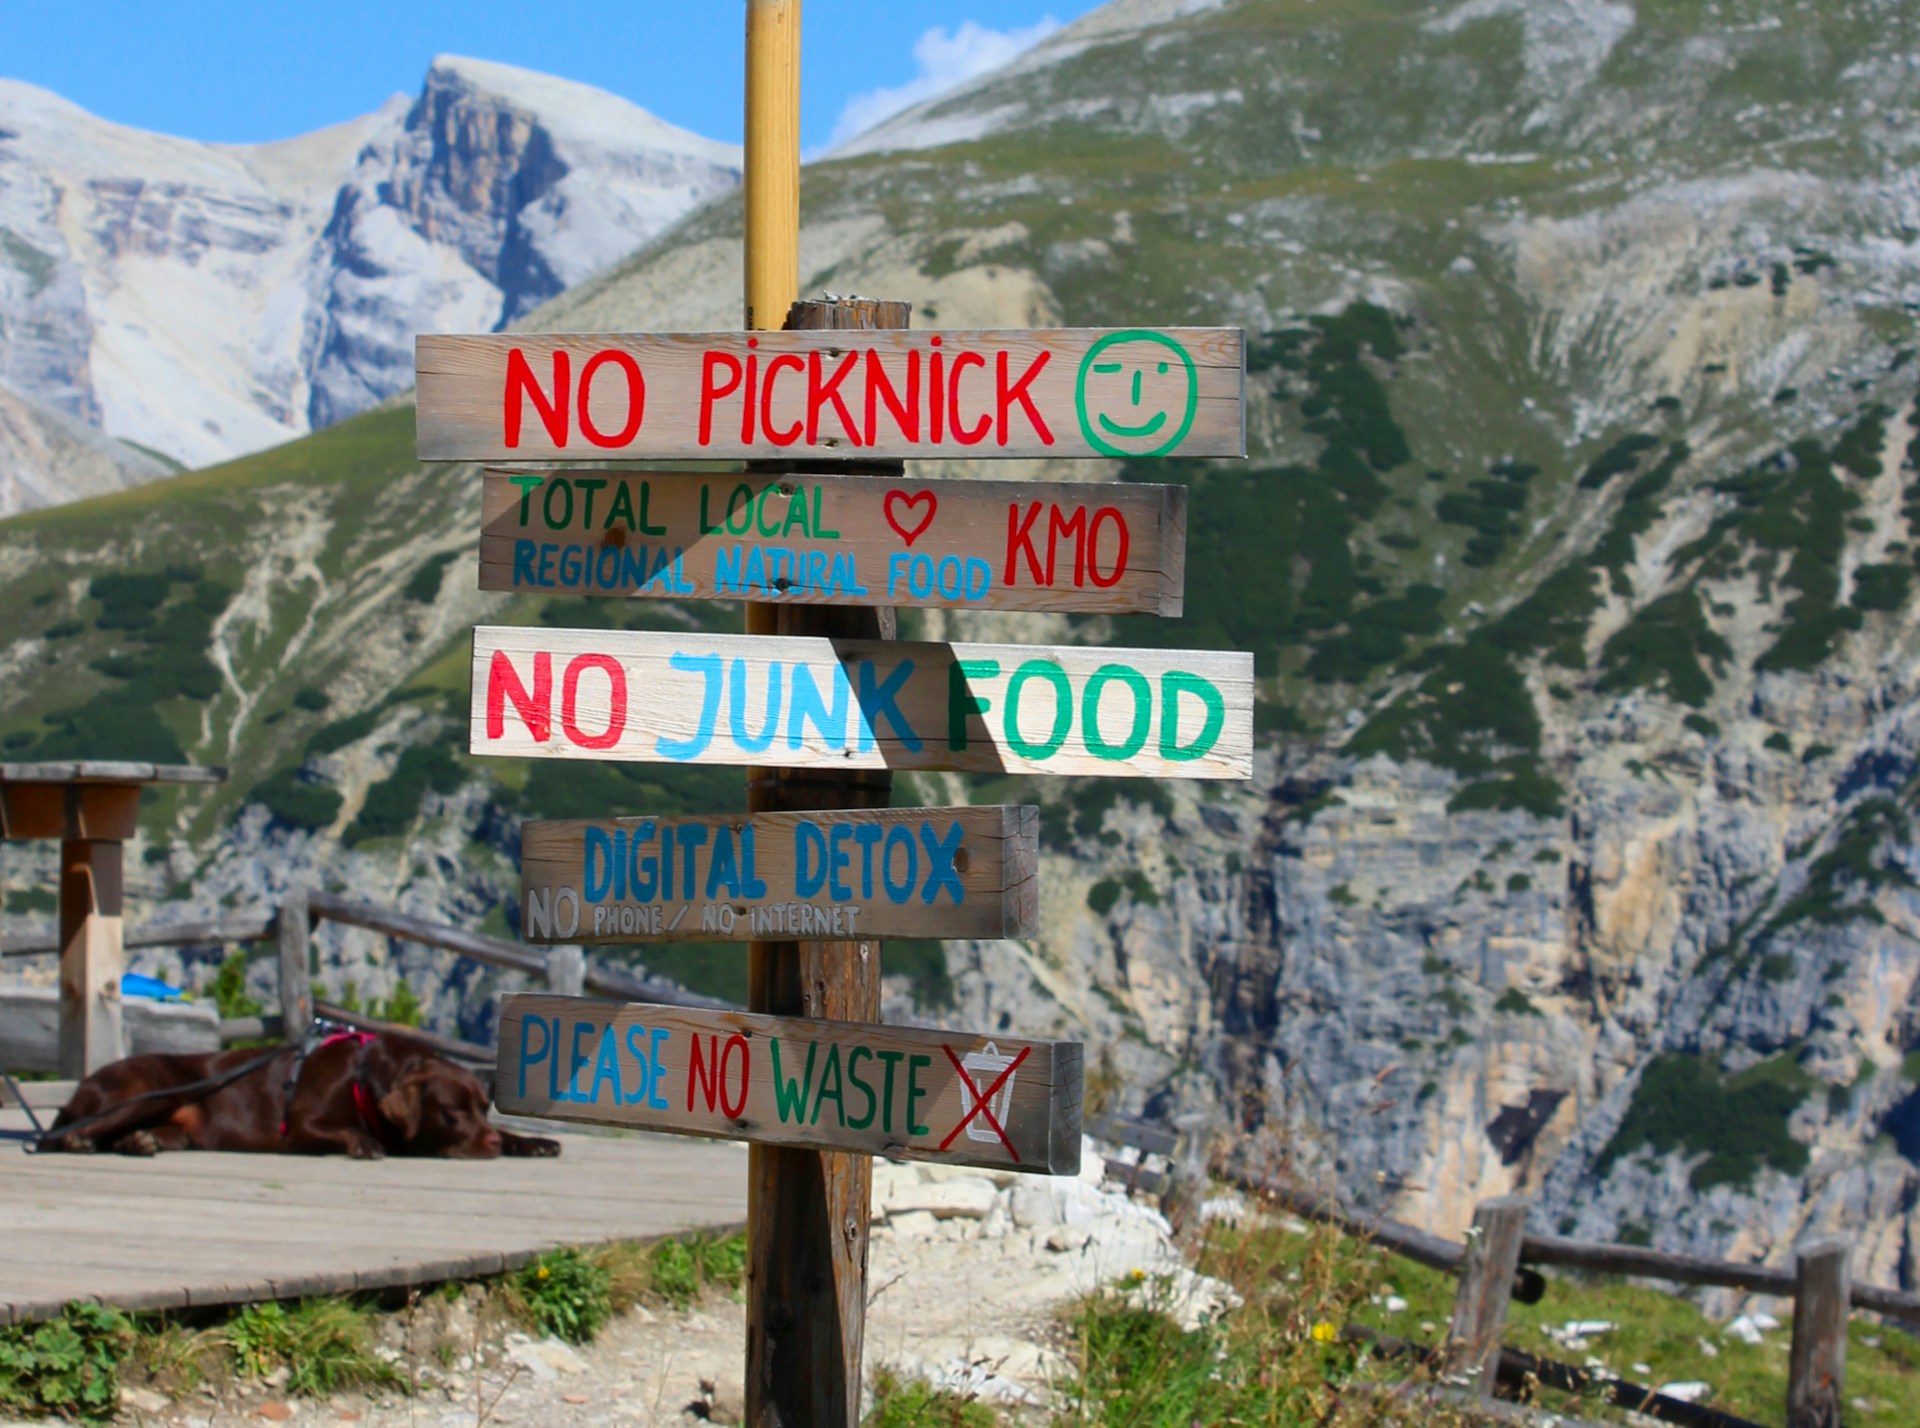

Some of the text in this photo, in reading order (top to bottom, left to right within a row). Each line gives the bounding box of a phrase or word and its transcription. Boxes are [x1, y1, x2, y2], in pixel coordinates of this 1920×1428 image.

[504, 348, 645, 448] NO
[509, 476, 840, 539] TOTAL LOCAL
[513, 539, 992, 601] REGIONAL NATURAL FOOD
[486, 649, 1225, 761] NO JUNK FOOD
[584, 820, 965, 905] DIGITAL DETOX
[526, 886, 580, 939] NO
[702, 905, 737, 935] NO
[751, 903, 861, 938] INTERNET
[518, 1013, 932, 1136] PLEASE NO WASTE
